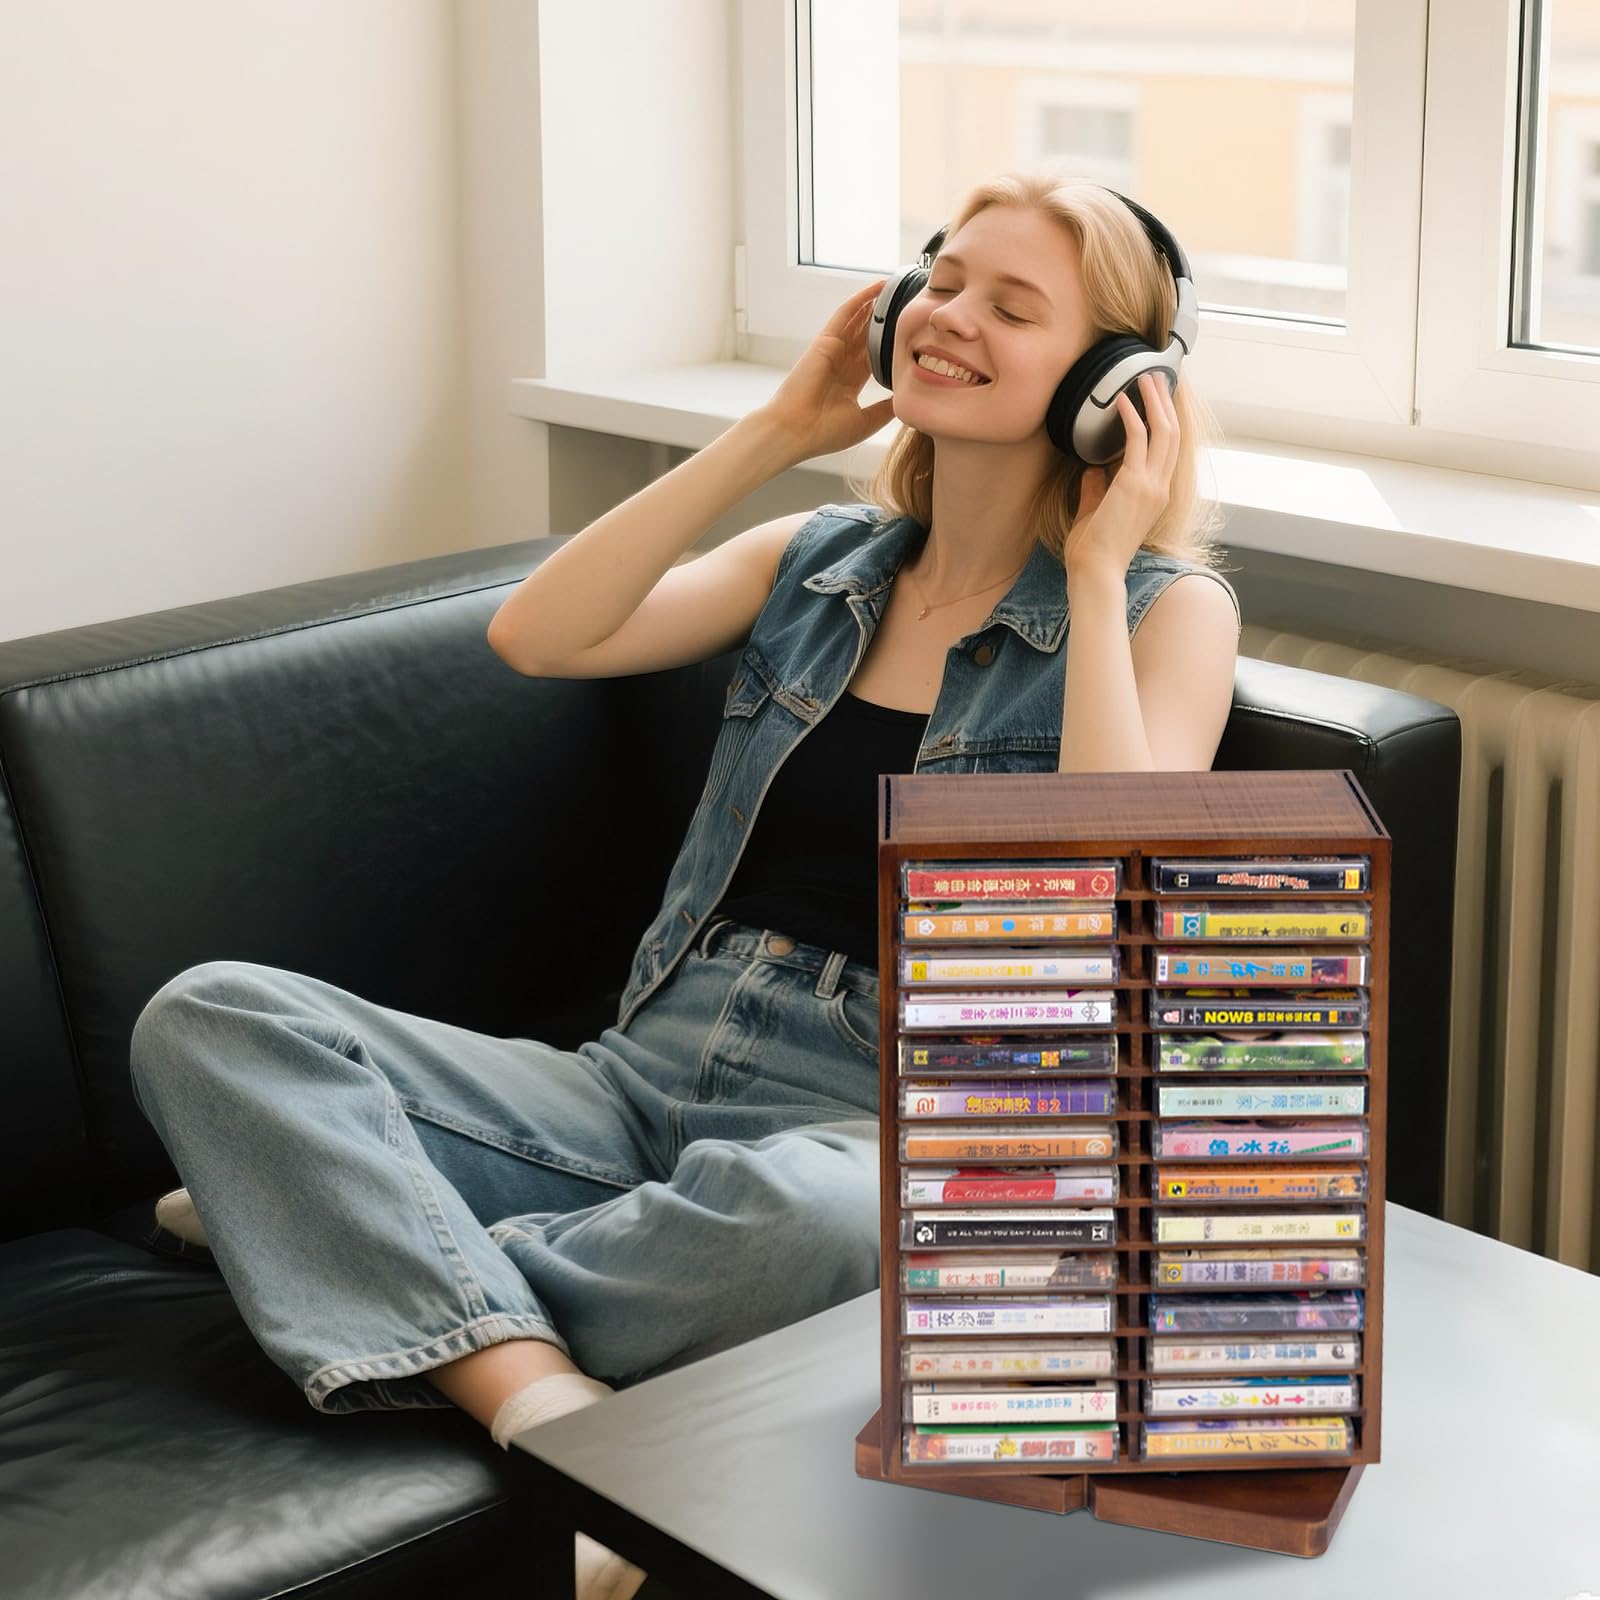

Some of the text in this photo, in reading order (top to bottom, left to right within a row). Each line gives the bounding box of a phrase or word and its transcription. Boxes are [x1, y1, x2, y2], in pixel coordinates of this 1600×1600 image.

[959, 1229, 972, 1238] ALL
[974, 1229, 991, 1238] THAT
[993, 1229, 1008, 1238] YOU
[1032, 1229, 1054, 1238] LEAVE
[1055, 1229, 1083, 1238] BEHIND
